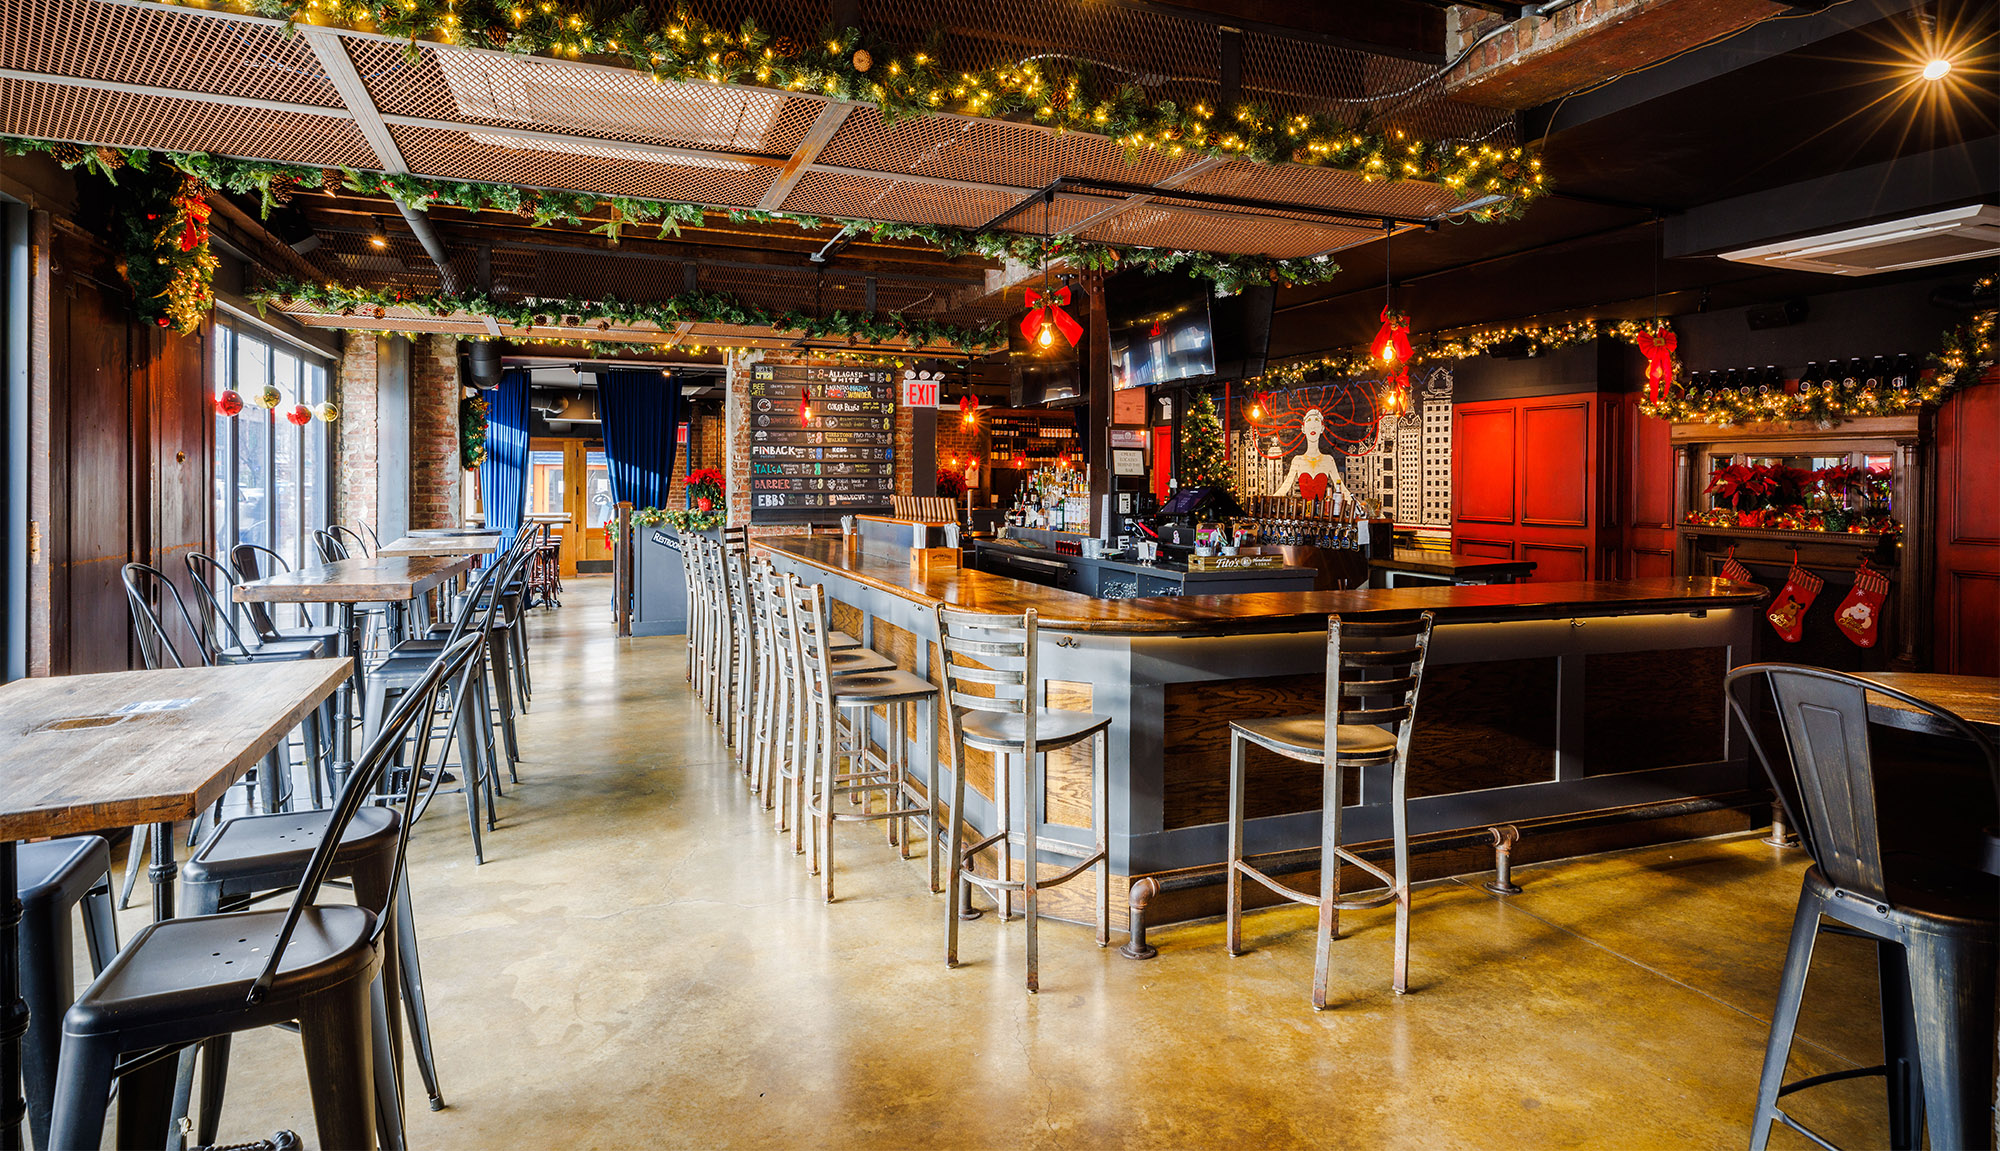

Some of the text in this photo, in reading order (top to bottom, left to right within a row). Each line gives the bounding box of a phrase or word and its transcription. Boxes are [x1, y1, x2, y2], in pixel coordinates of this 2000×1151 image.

[817, 368, 824, 379] 8
[828, 370, 864, 378] ALLAGASH
[848, 391, 873, 399] WONDER
[909, 384, 937, 405] EXIT
[887, 403, 894, 414] 8
[883, 418, 890, 430] 8
[816, 432, 823, 443] 8
[753, 446, 795, 455] FINBACK
[755, 479, 791, 489] BARRIER
[817, 478, 824, 489] 8
[758, 493, 785, 507] EBBS
[817, 494, 823, 506] 8
